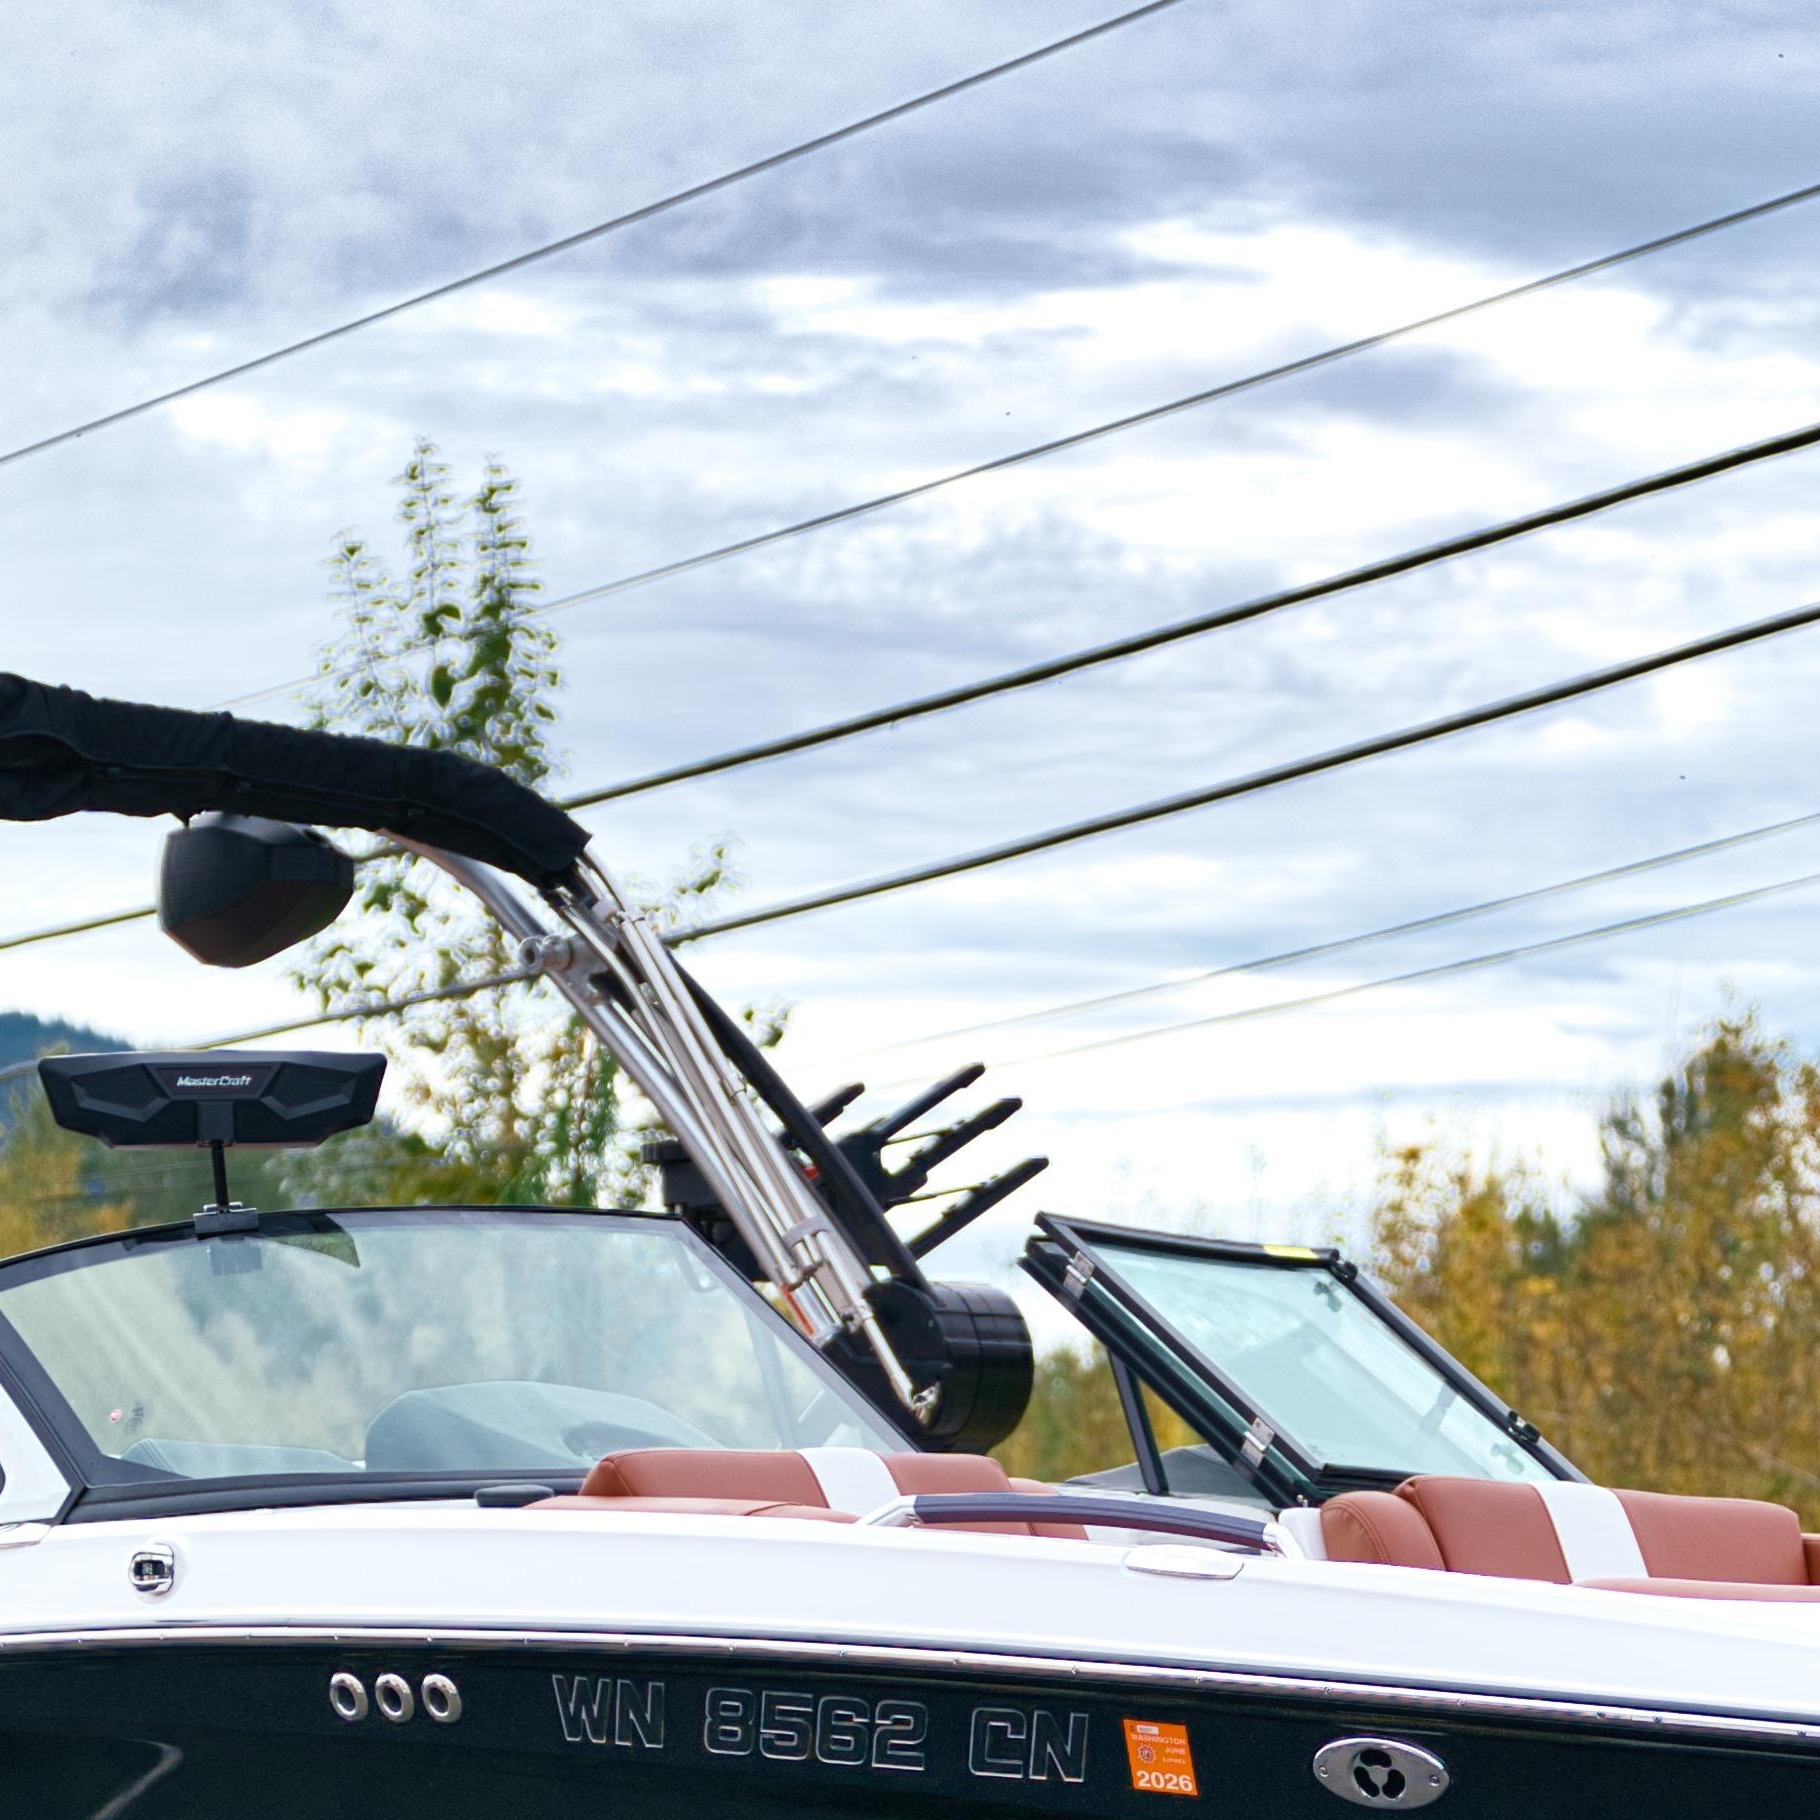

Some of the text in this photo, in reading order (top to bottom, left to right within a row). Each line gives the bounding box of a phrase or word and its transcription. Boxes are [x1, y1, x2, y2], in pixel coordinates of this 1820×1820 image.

[176, 1075, 252, 1087] MasterCraft
[552, 1673, 1090, 1783] WN 8562 CN
[1130, 1733, 1186, 1745] WASHINGTON
[1164, 1746, 1186, 1756] JUNE
[1136, 1769, 1193, 1792] 2026
